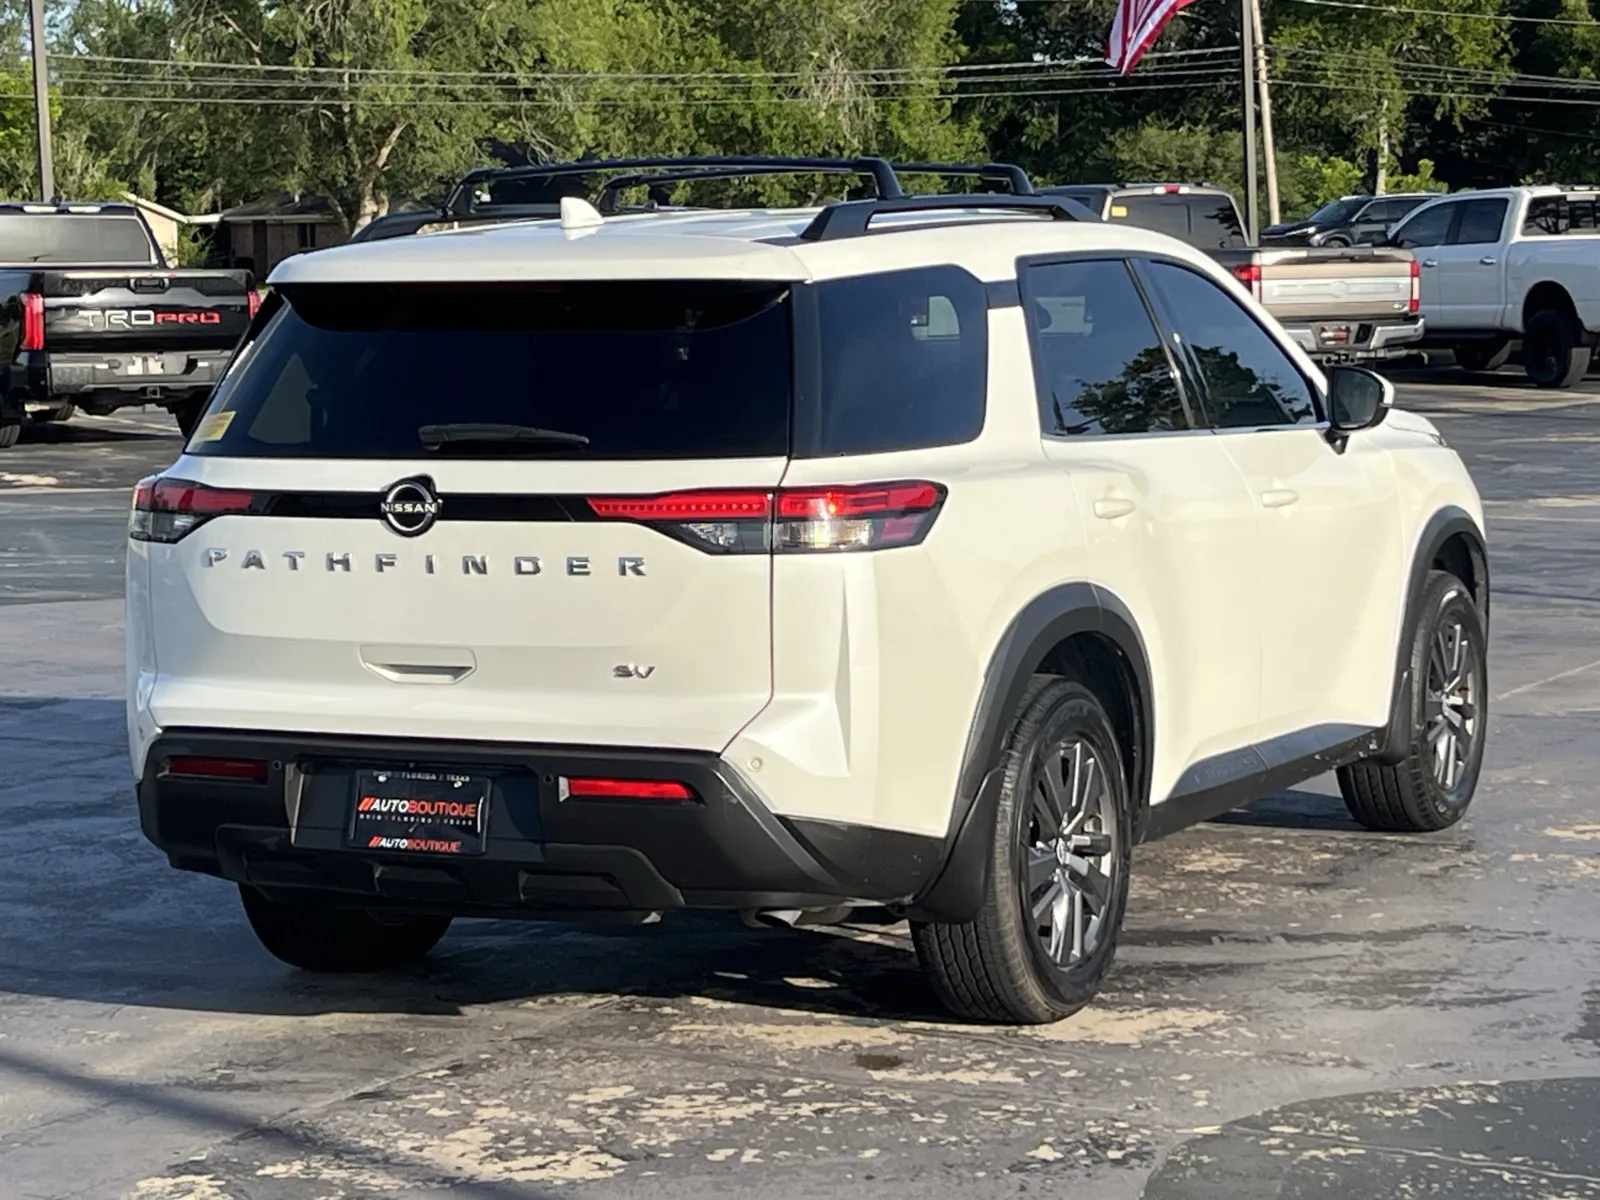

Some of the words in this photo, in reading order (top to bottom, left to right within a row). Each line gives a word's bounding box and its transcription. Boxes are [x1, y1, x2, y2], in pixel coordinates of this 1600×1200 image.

[78, 310, 155, 328] TRD
[156, 312, 220, 324] PRO
[381, 503, 437, 514] NISSAN
[203, 547, 647, 577] PATHFINDER
[613, 665, 655, 679] SV
[369, 799, 477, 817] AUTOBOUTIQUE
[379, 837, 461, 852] AUTOBOUTIQUE
